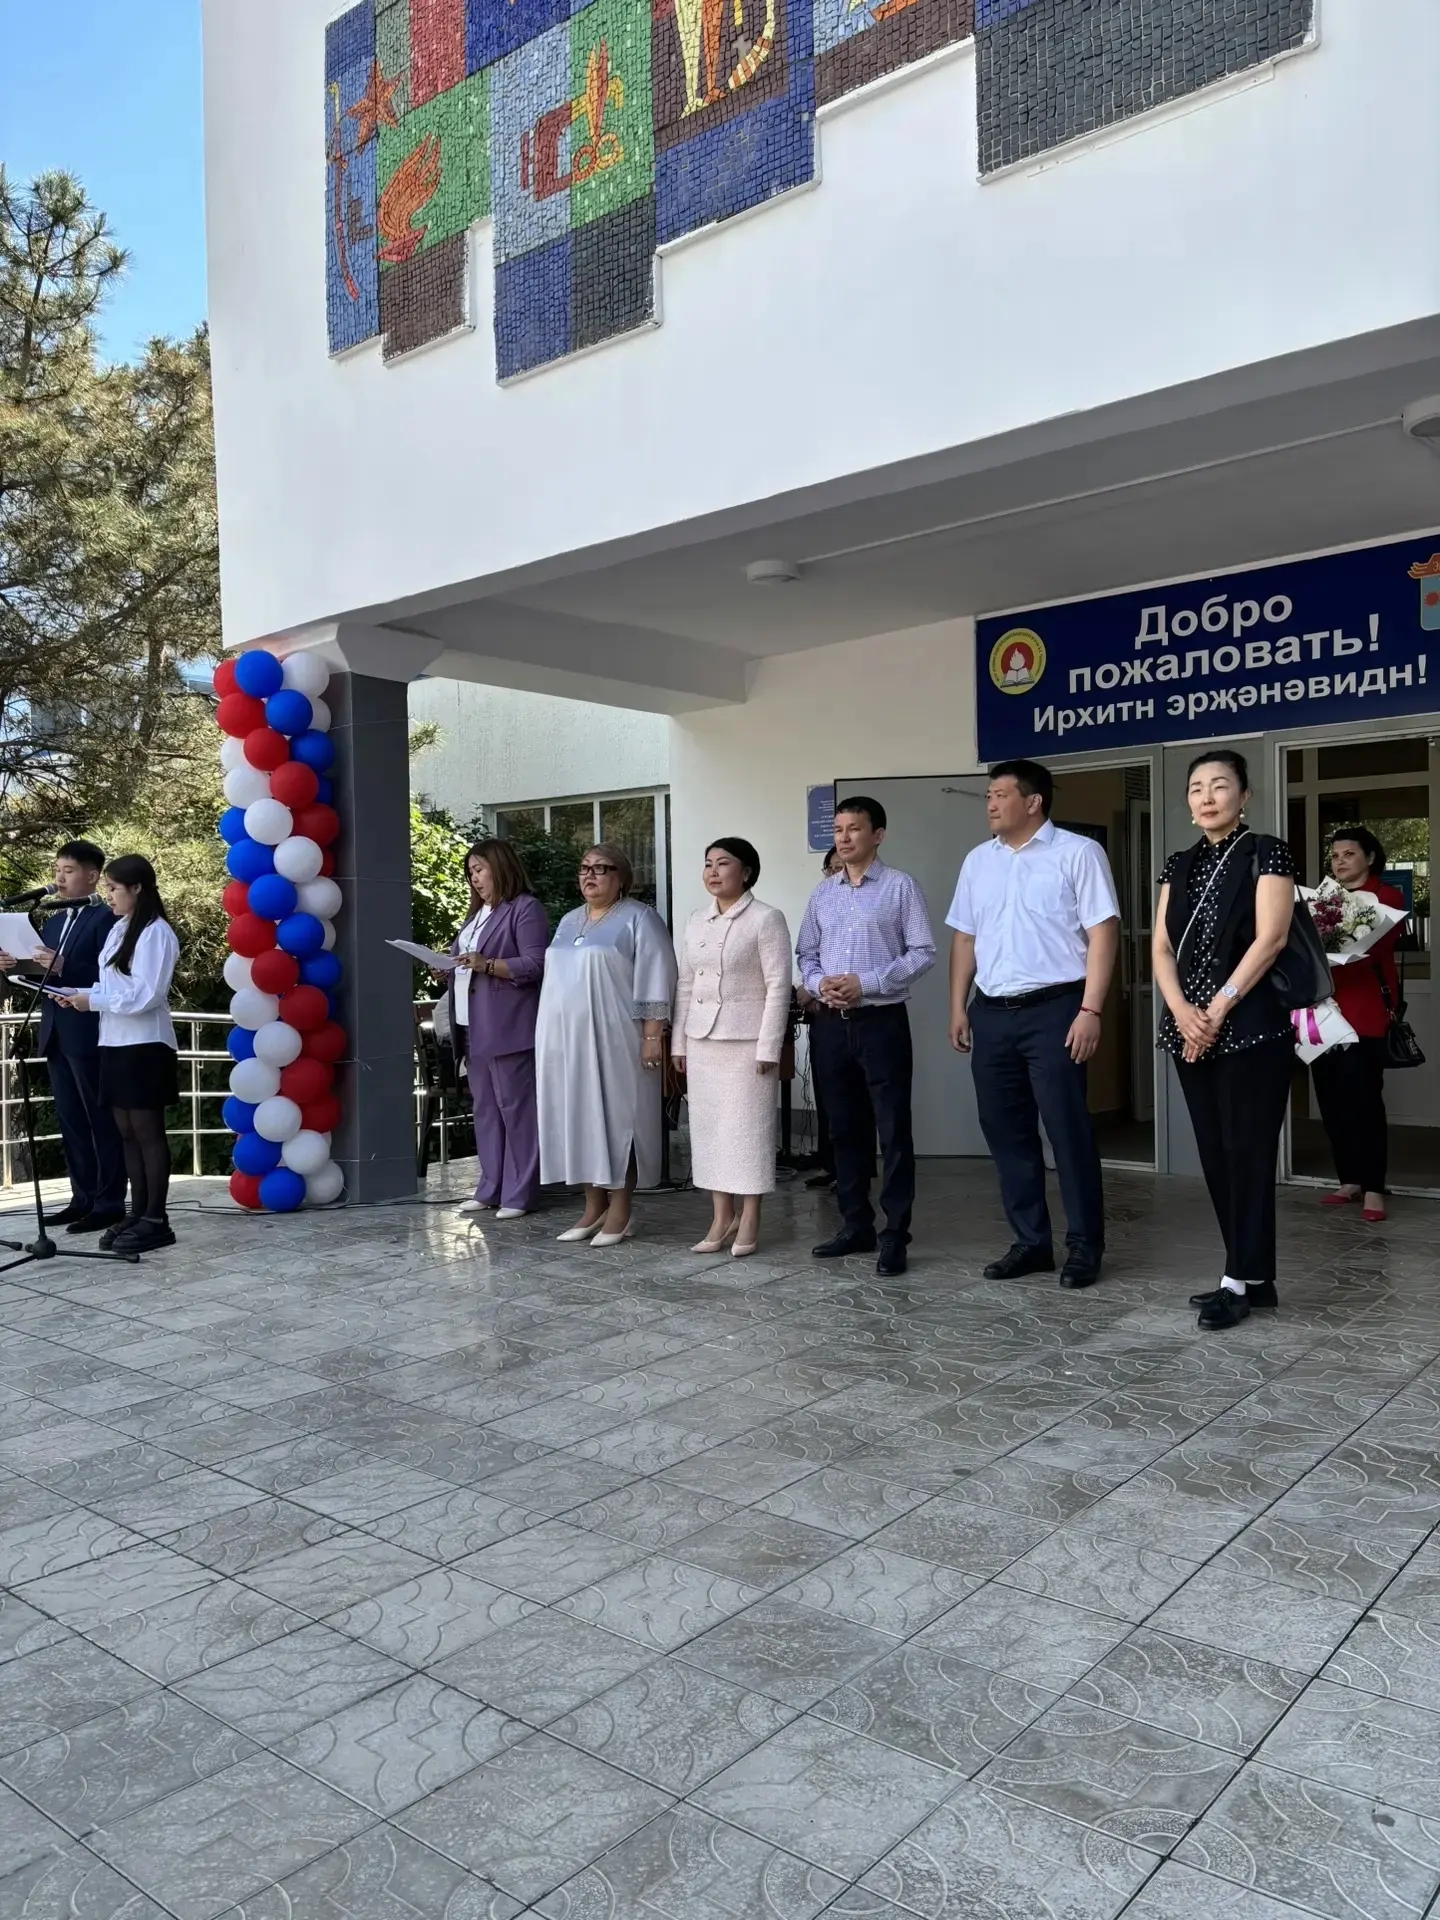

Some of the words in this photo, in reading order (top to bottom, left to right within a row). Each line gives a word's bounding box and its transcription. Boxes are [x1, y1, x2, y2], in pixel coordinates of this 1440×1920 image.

[1069, 613, 1379, 694] пожаловать!
[1134, 594, 1293, 650] Добро
[1034, 698, 1154, 736] Ирхитн
[1166, 654, 1427, 721] эрҗәнәвидн!
